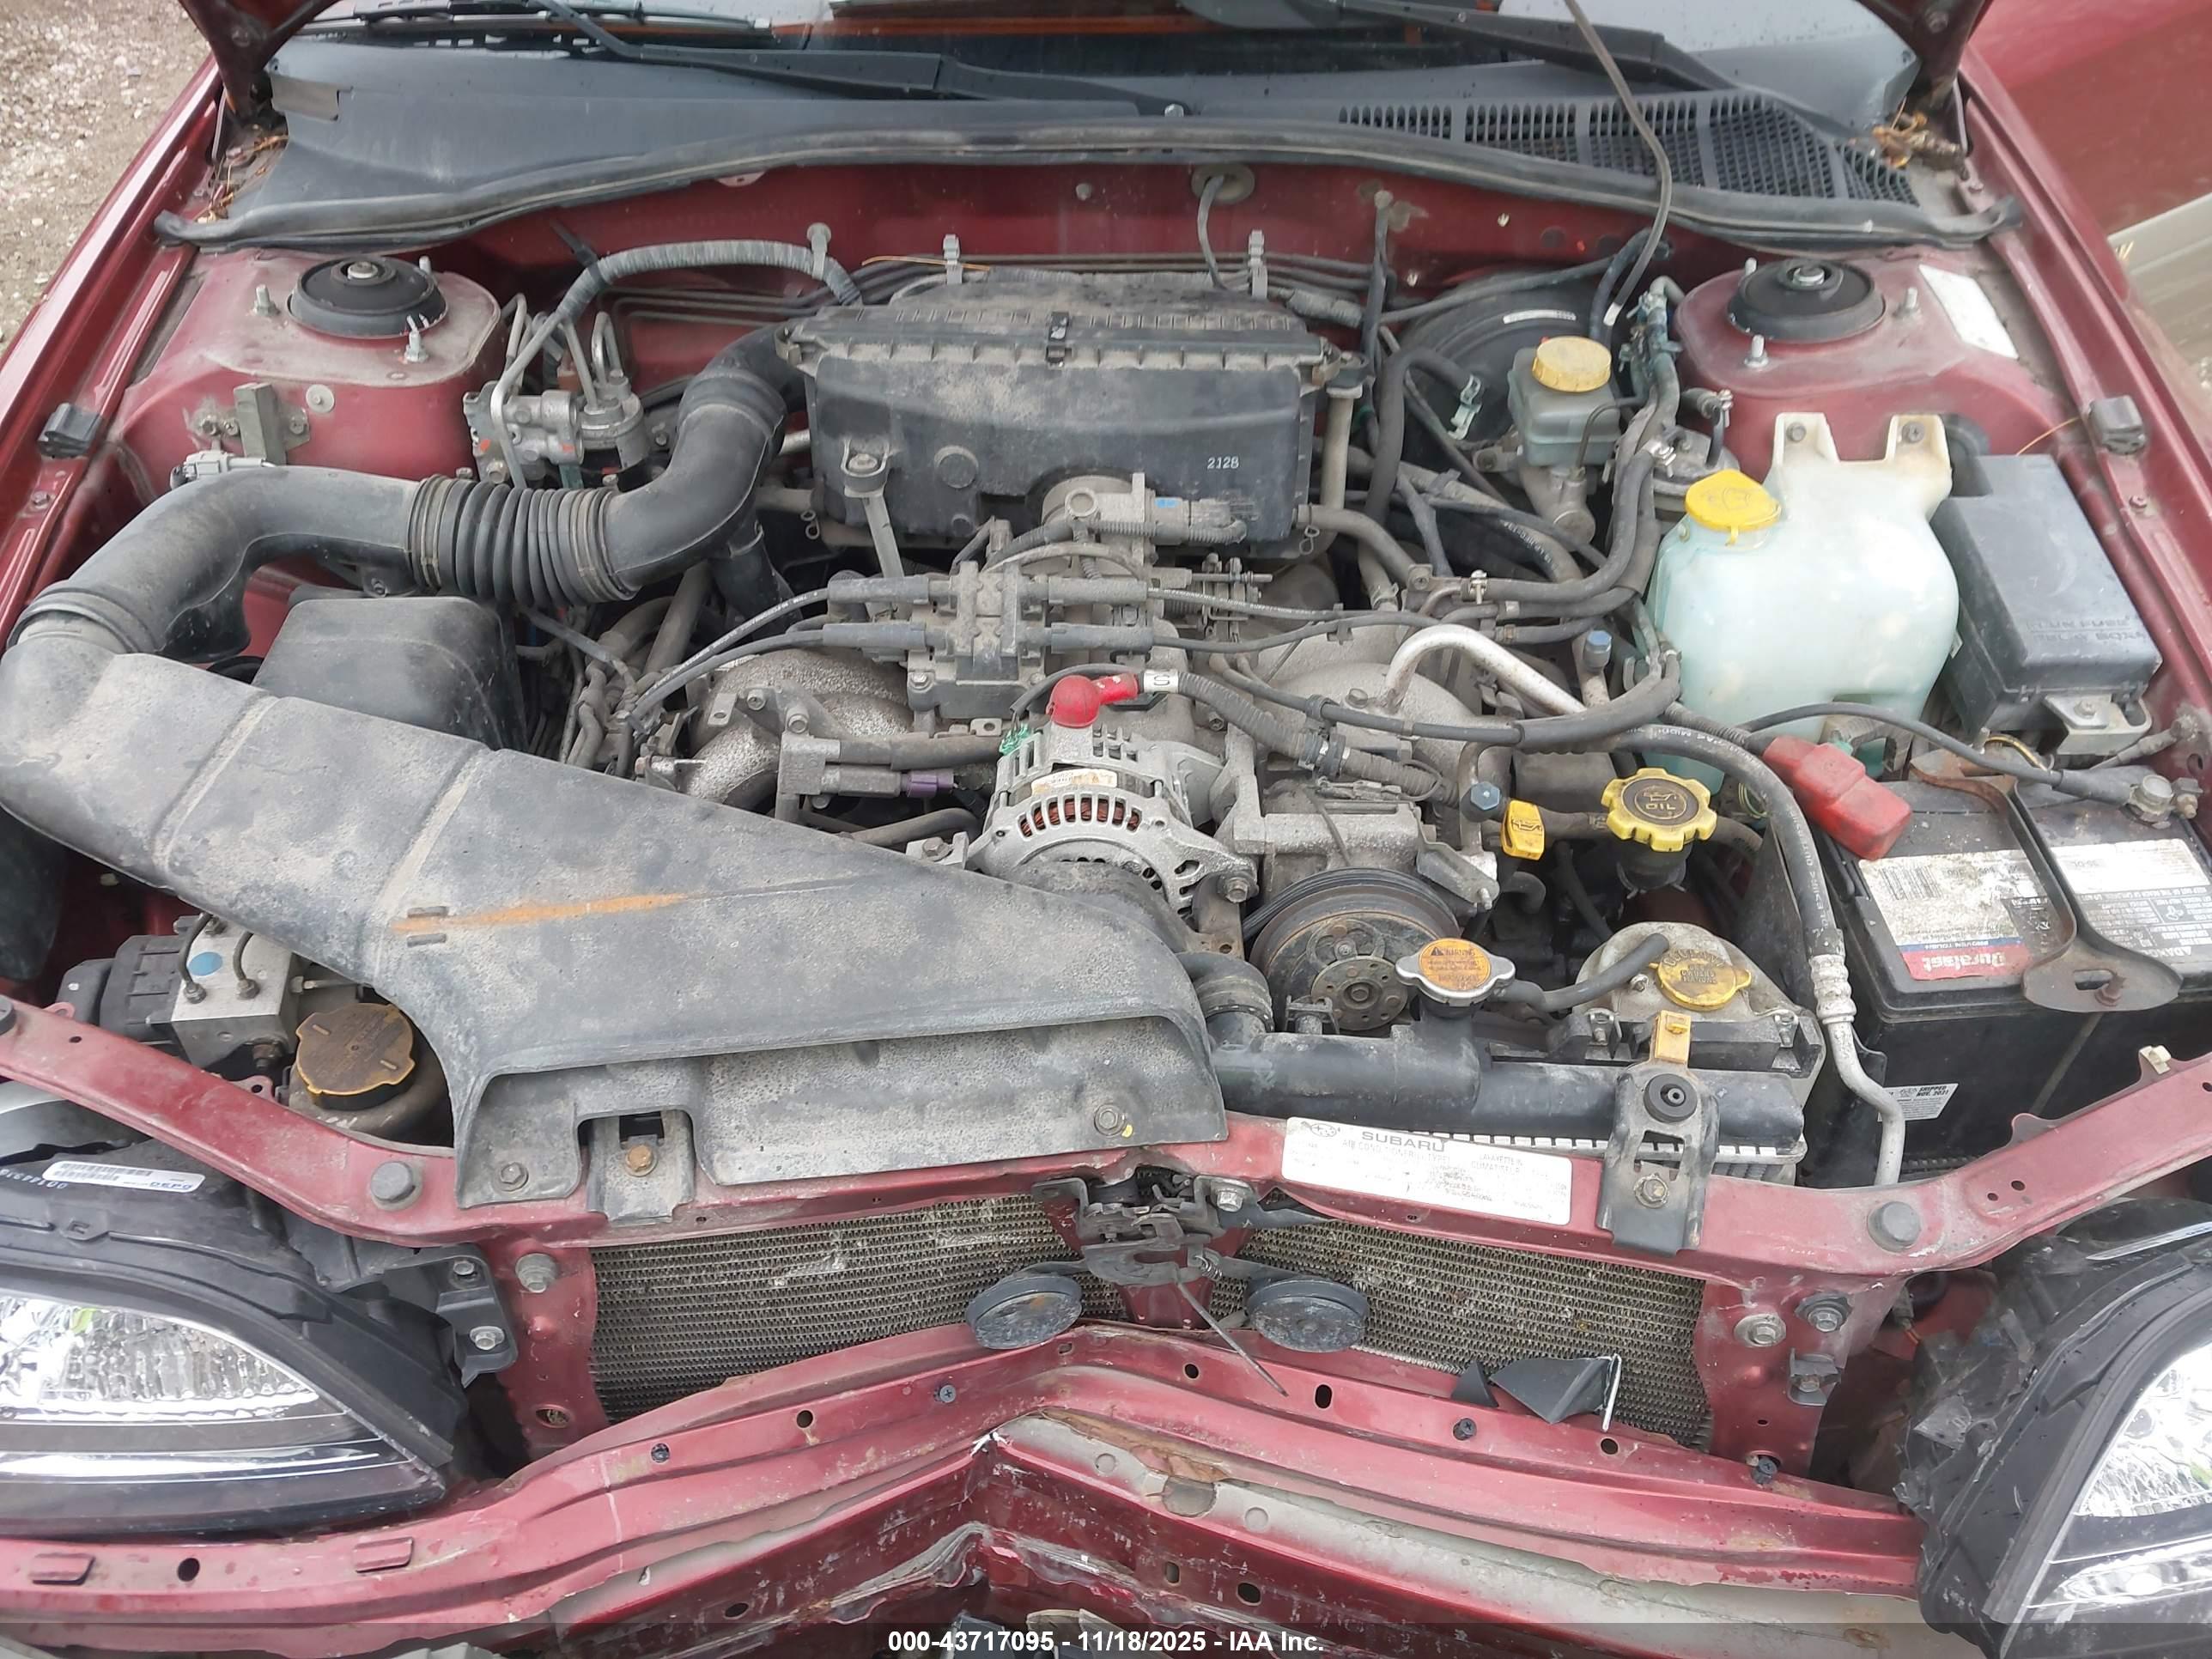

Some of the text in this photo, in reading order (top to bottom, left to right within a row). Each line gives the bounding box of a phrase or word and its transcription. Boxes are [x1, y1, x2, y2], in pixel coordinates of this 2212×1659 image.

[1153, 673, 1170, 686] S
[1922, 951, 2007, 972] Duralast
[1362, 1131, 1445, 1152] SUBARU
[150, 1182, 193, 1191] DEPO
